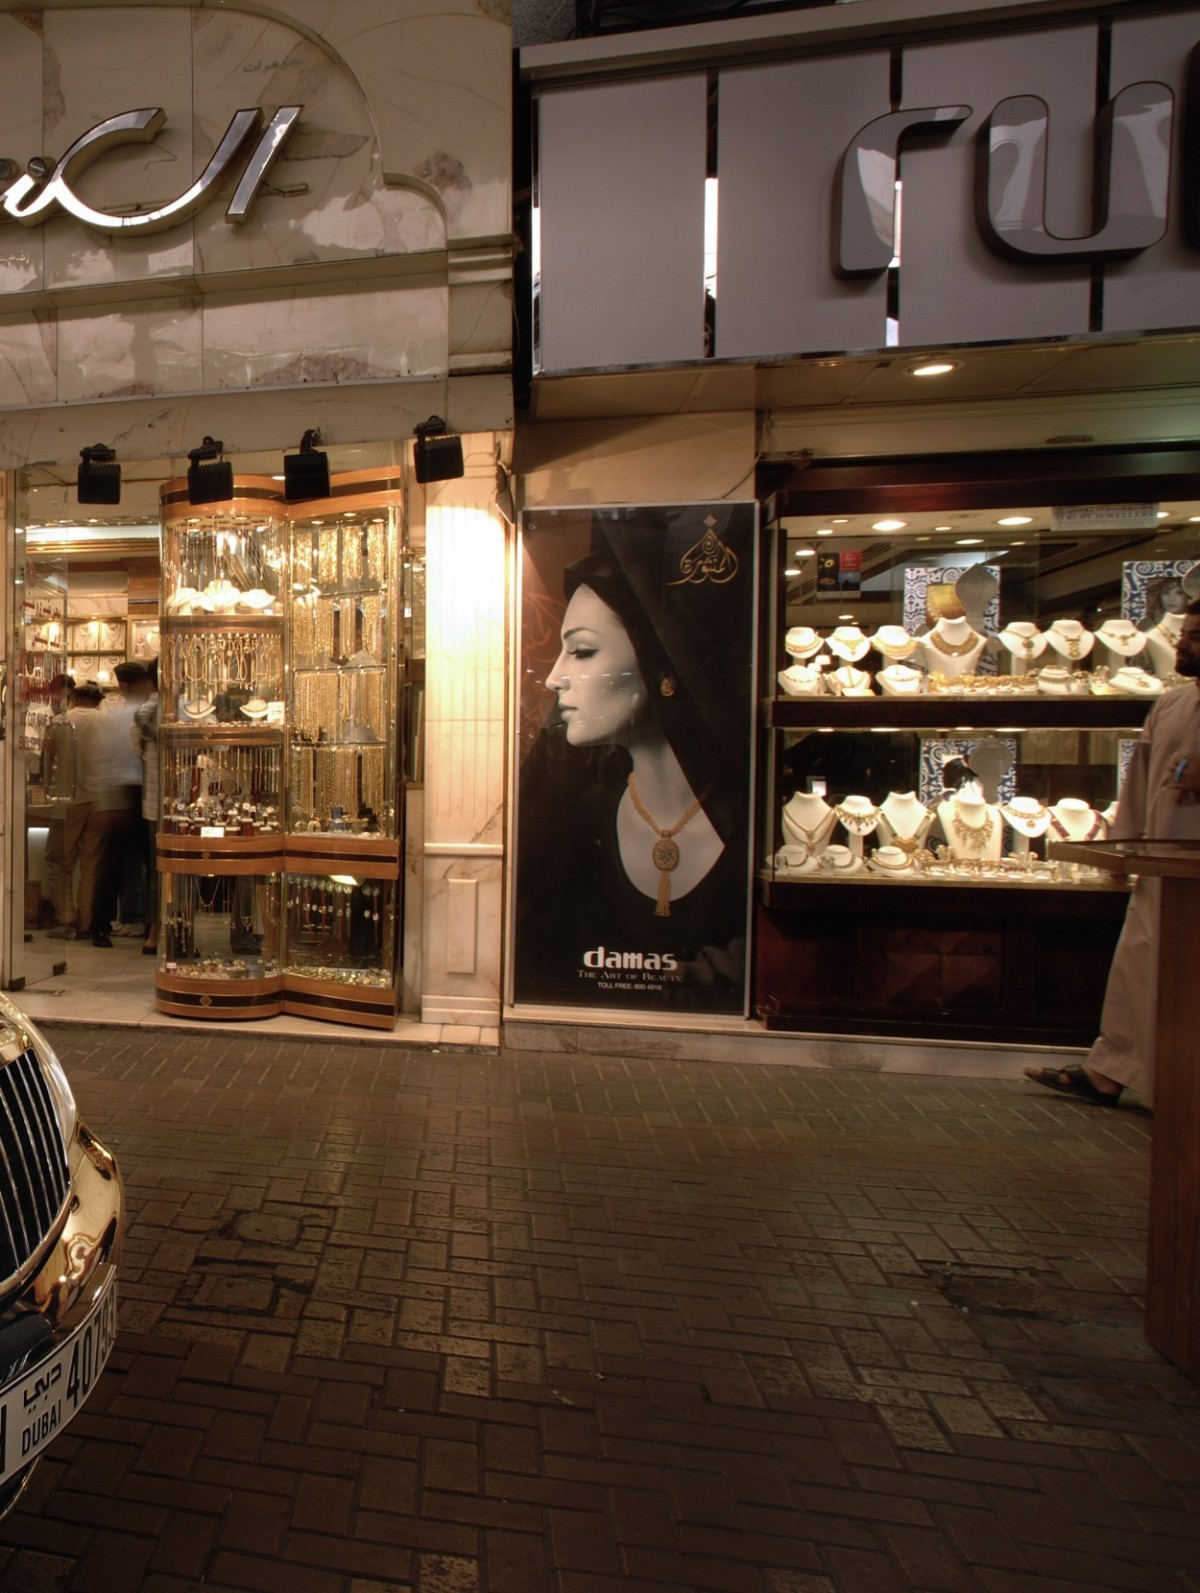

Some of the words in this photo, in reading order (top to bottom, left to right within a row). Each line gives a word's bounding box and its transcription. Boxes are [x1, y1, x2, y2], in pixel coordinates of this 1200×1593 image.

[831, 41, 1200, 281] ru
[583, 946, 678, 971] damas
[24, 1363, 61, 1414] دبي
[22, 1397, 61, 1457] DUBAI
